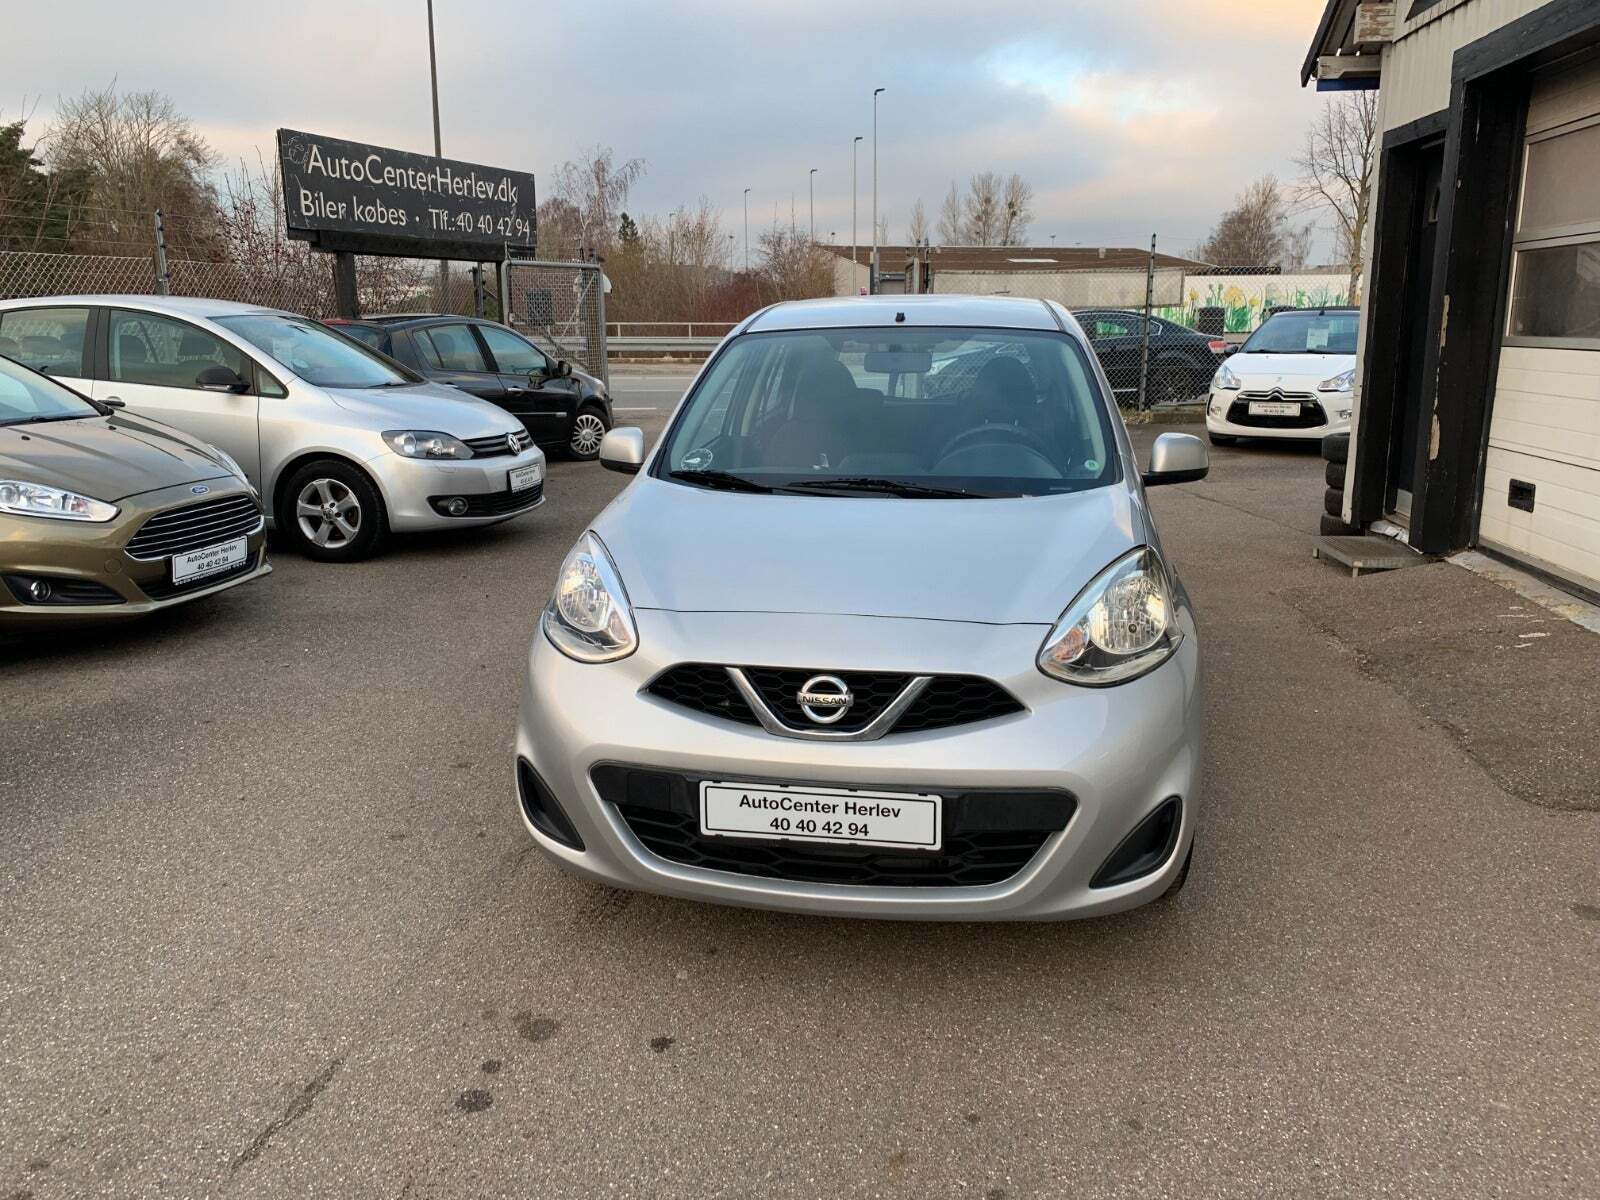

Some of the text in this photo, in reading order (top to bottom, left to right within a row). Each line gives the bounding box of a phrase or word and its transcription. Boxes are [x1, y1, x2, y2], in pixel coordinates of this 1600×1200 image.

[307, 143, 518, 204] AutoCenterHerlev.dk
[300, 189, 346, 220] Biler
[353, 195, 406, 226] købes
[477, 214, 493, 235] 40
[497, 216, 512, 236] 42
[515, 218, 530, 241] 94
[802, 695, 847, 705] NISSAN
[739, 794, 901, 818] AutoCenter Herlev
[770, 817, 869, 836] 40 40 42 94
